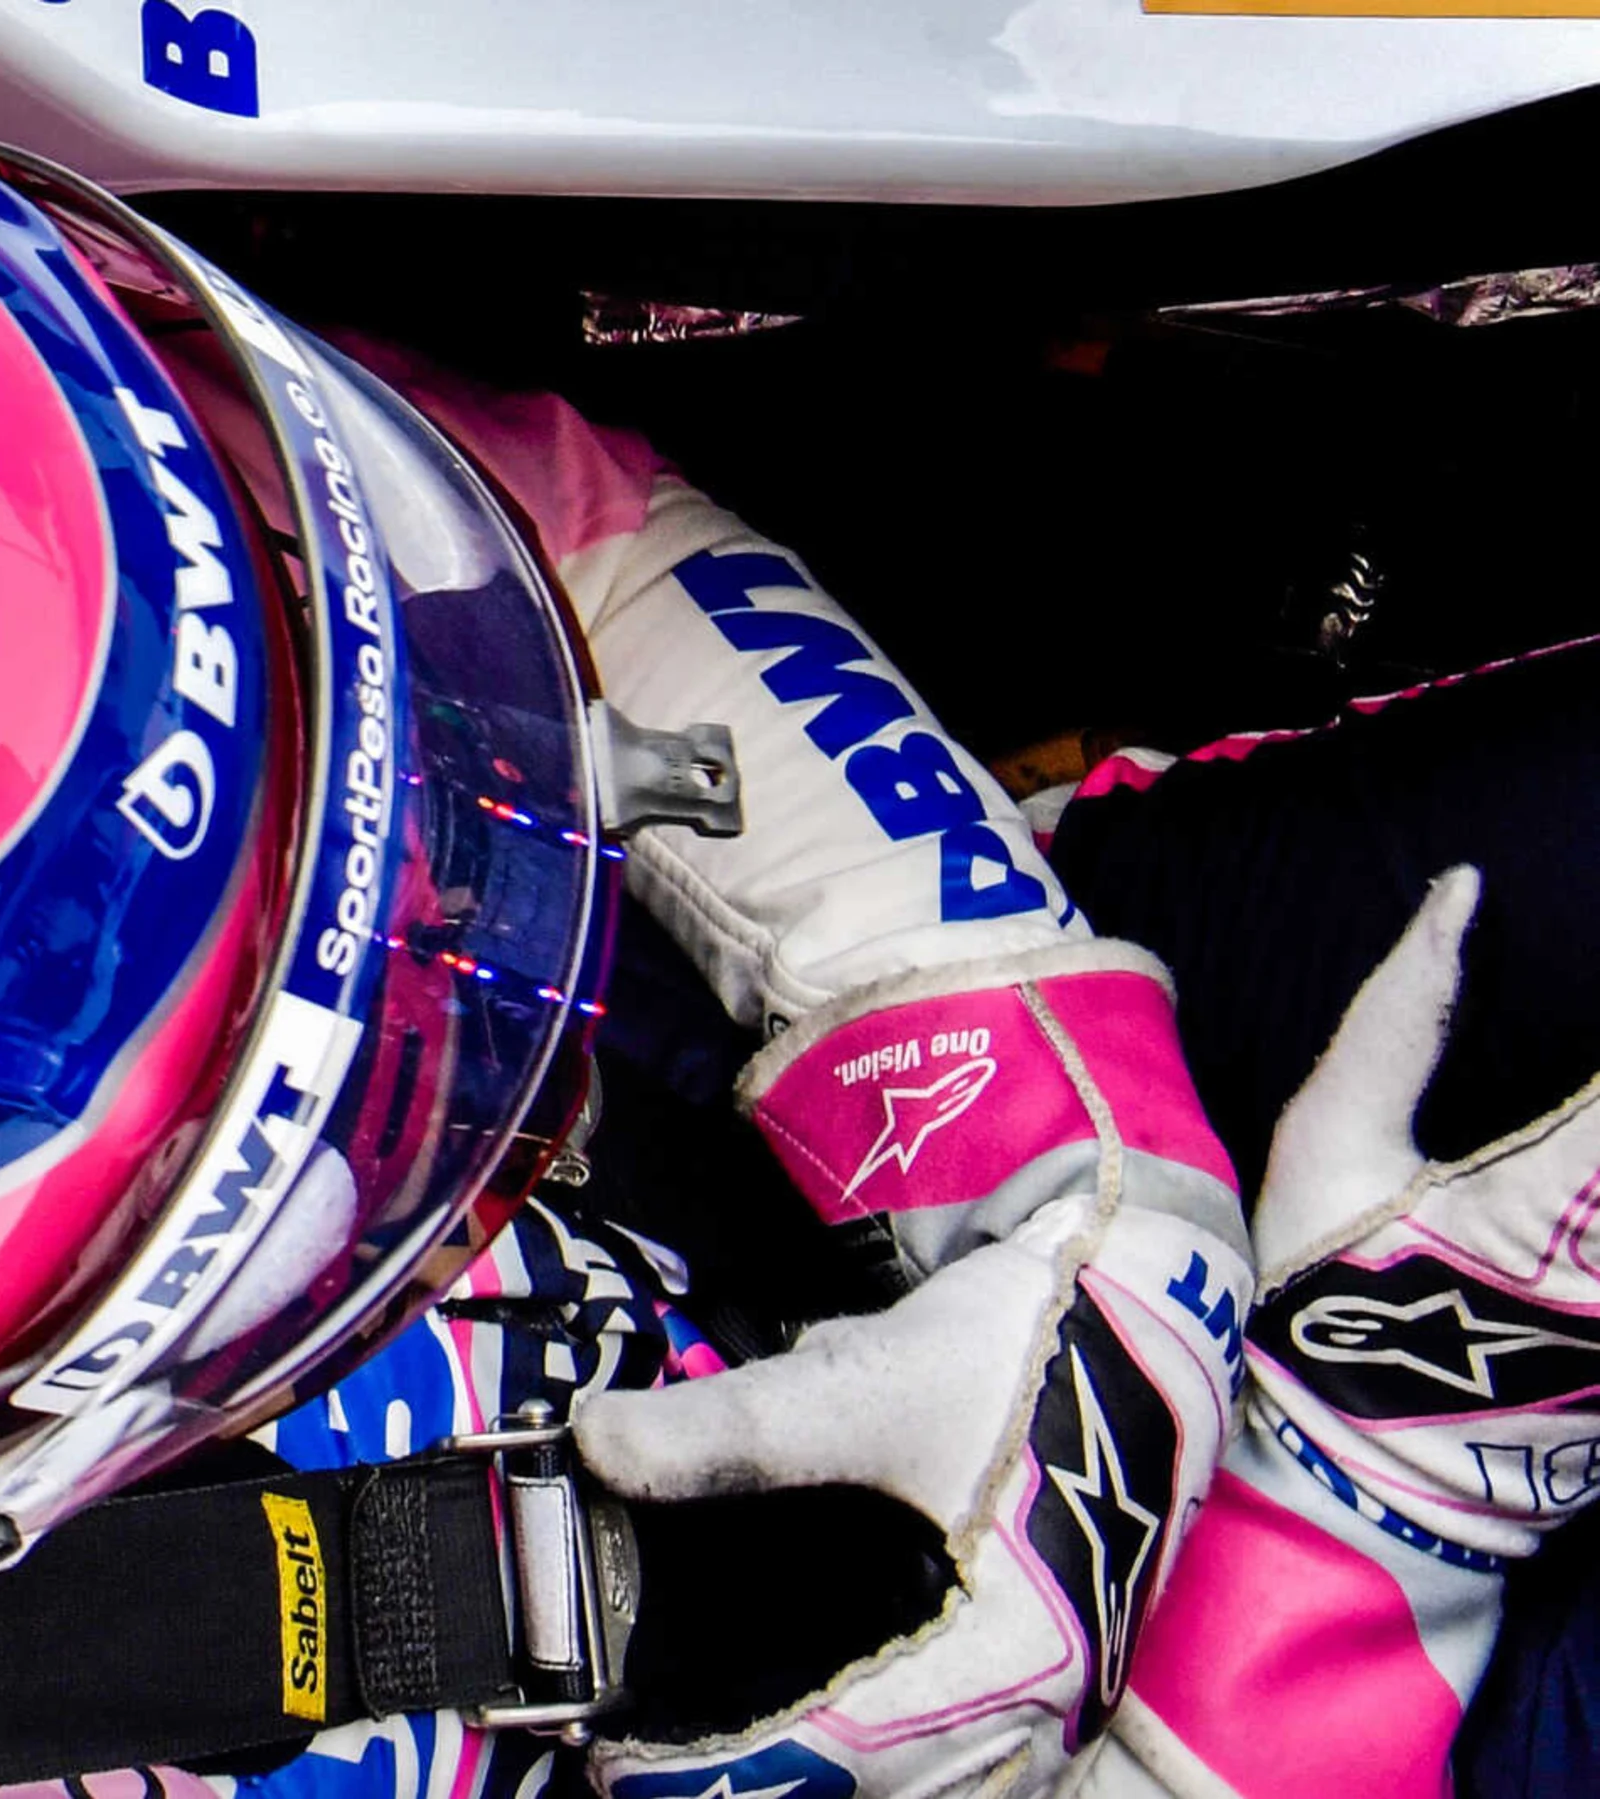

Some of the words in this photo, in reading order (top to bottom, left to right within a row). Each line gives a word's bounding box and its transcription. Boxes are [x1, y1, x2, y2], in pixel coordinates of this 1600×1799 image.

[113, 386, 238, 728] BWT
[314, 437, 382, 637] Racing
[670, 547, 987, 842] BWT
[317, 650, 385, 977] SportPesa
[833, 1039, 921, 1086] Vision.
[930, 1027, 991, 1057] One
[137, 1061, 320, 1309] BWT
[291, 1525, 323, 1696] Sabelt
